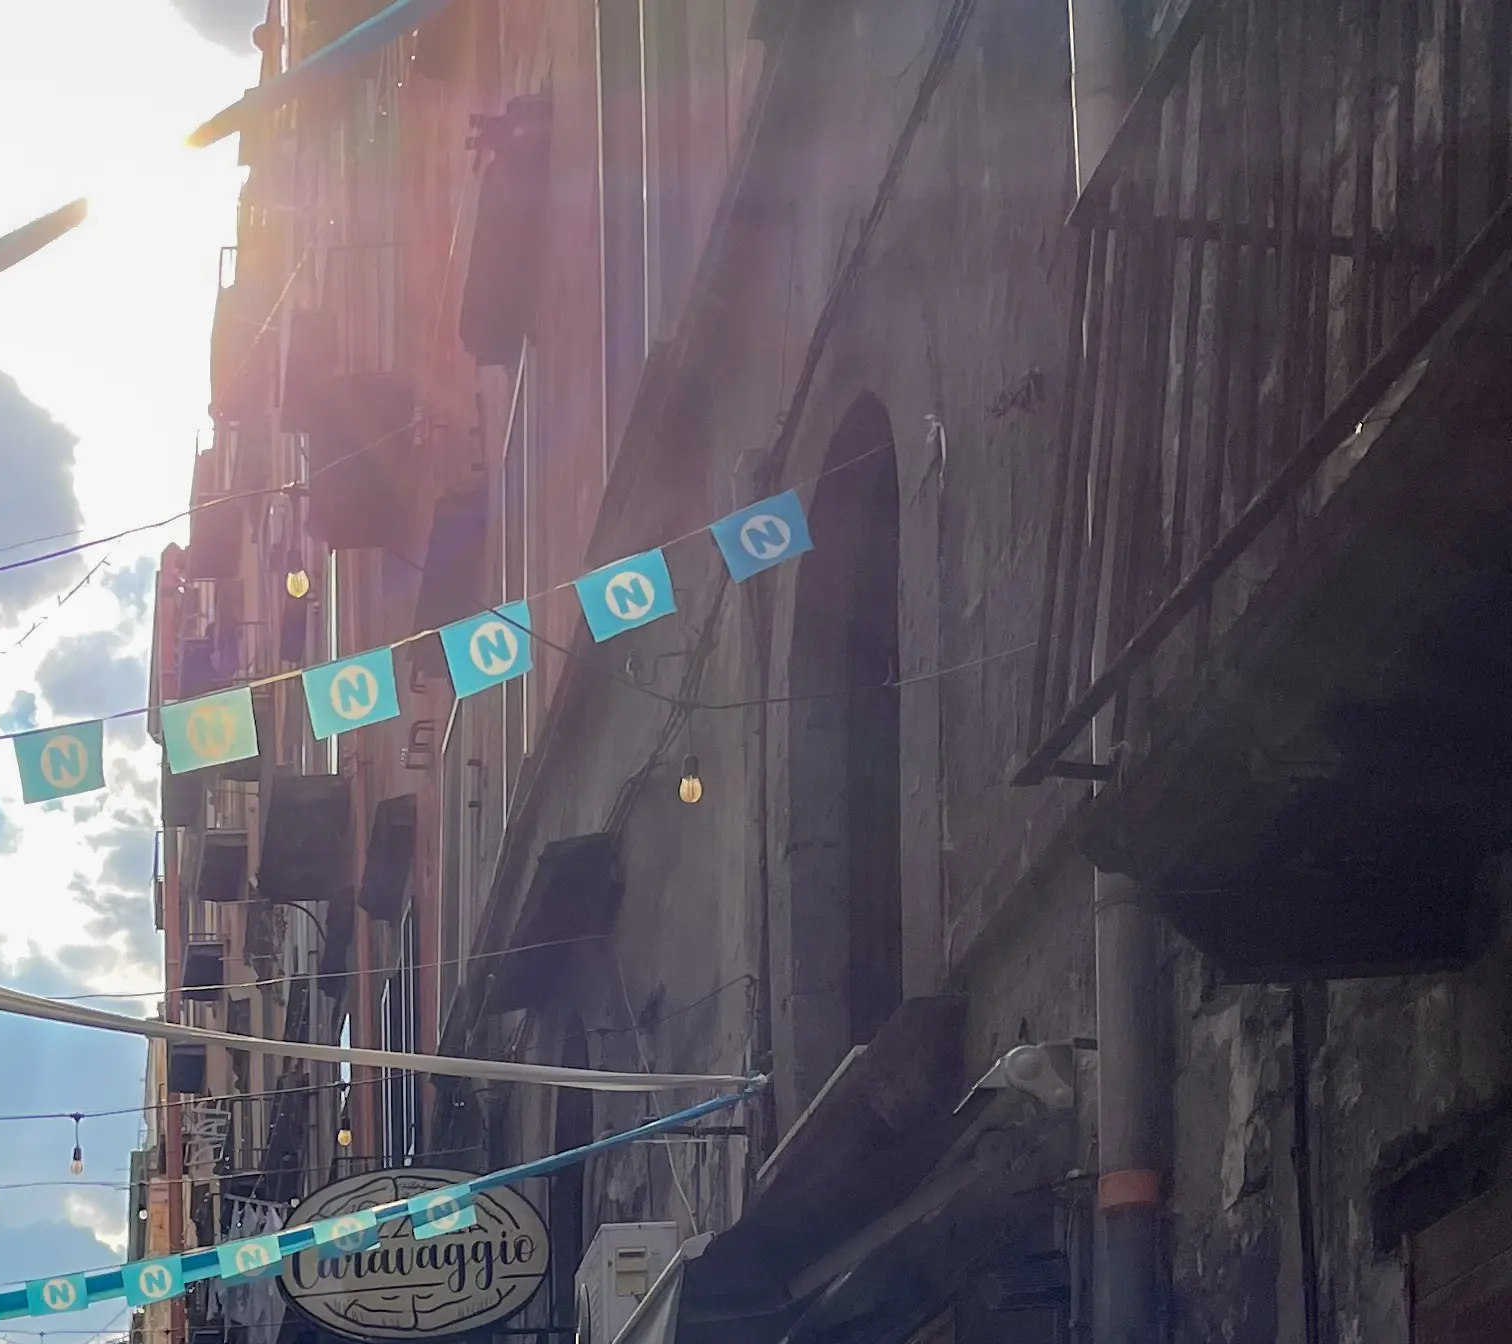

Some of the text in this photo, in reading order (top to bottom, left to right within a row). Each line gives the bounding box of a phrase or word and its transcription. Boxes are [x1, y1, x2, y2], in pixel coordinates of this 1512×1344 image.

[746, 520, 785, 553] N
[611, 576, 648, 615] N
[476, 628, 511, 667] N
[336, 673, 369, 711] N
[196, 714, 226, 747] N
[49, 743, 79, 780] N
[241, 1248, 260, 1268] N
[291, 1231, 537, 1294] Caravaggio
[48, 1284, 69, 1304] N
[145, 1270, 165, 1291] N
